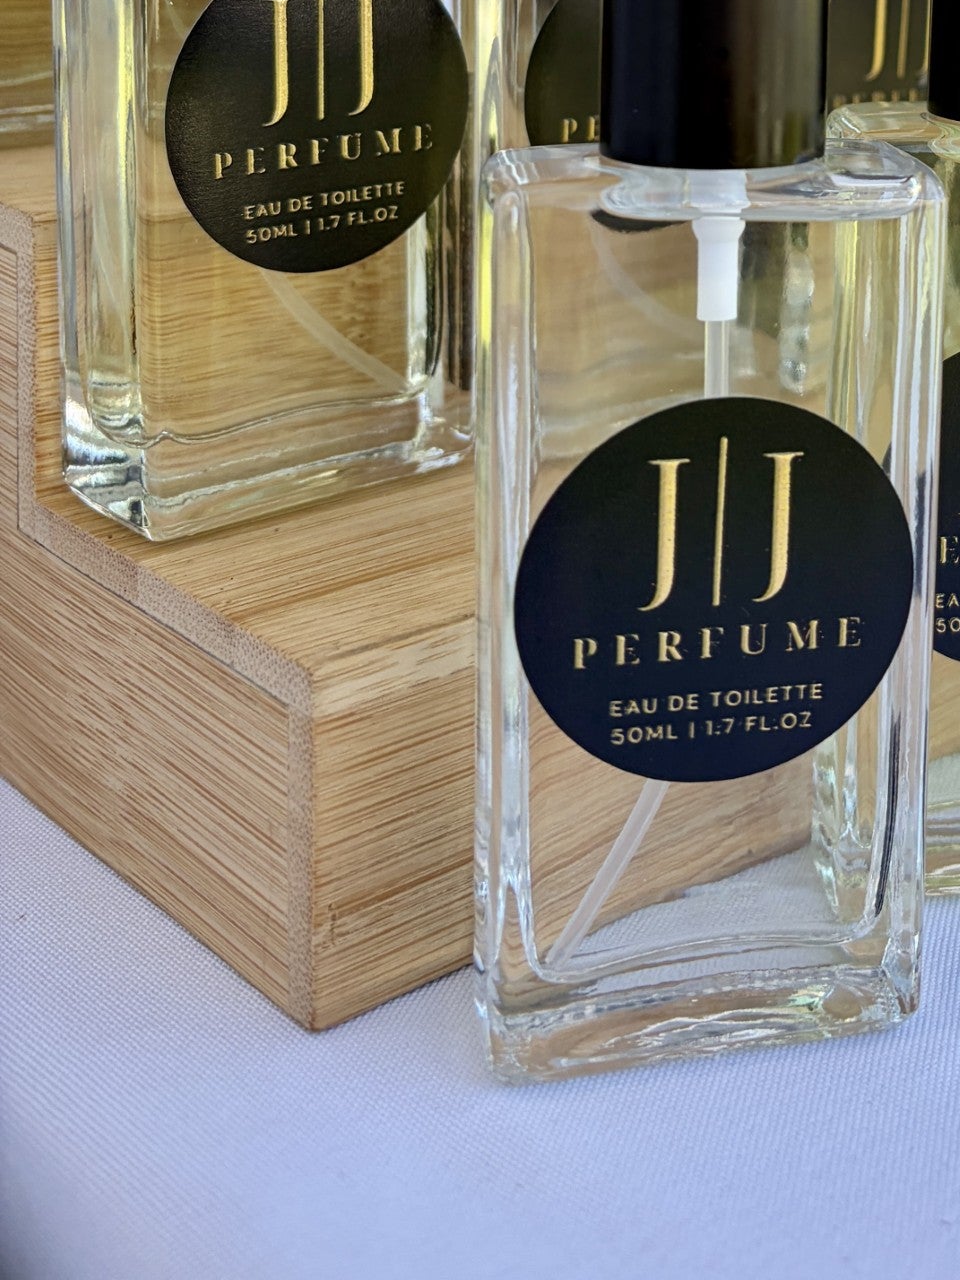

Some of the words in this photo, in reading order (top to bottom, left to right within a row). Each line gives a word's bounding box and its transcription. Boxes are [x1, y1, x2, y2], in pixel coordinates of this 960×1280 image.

[214, 123, 433, 180] PERFUME
[243, 200, 281, 220] EAU
[289, 195, 313, 213] DE
[320, 181, 406, 207] TOILETTE
[246, 225, 298, 244] 50ML
[318, 214, 339, 231] 1.7
[572, 617, 863, 670] PERFUME
[609, 694, 658, 717] EAU
[667, 692, 699, 712] DE
[710, 683, 824, 708] TOILETTE
[609, 724, 678, 745] 50ML
[705, 718, 734, 736] 1.7
